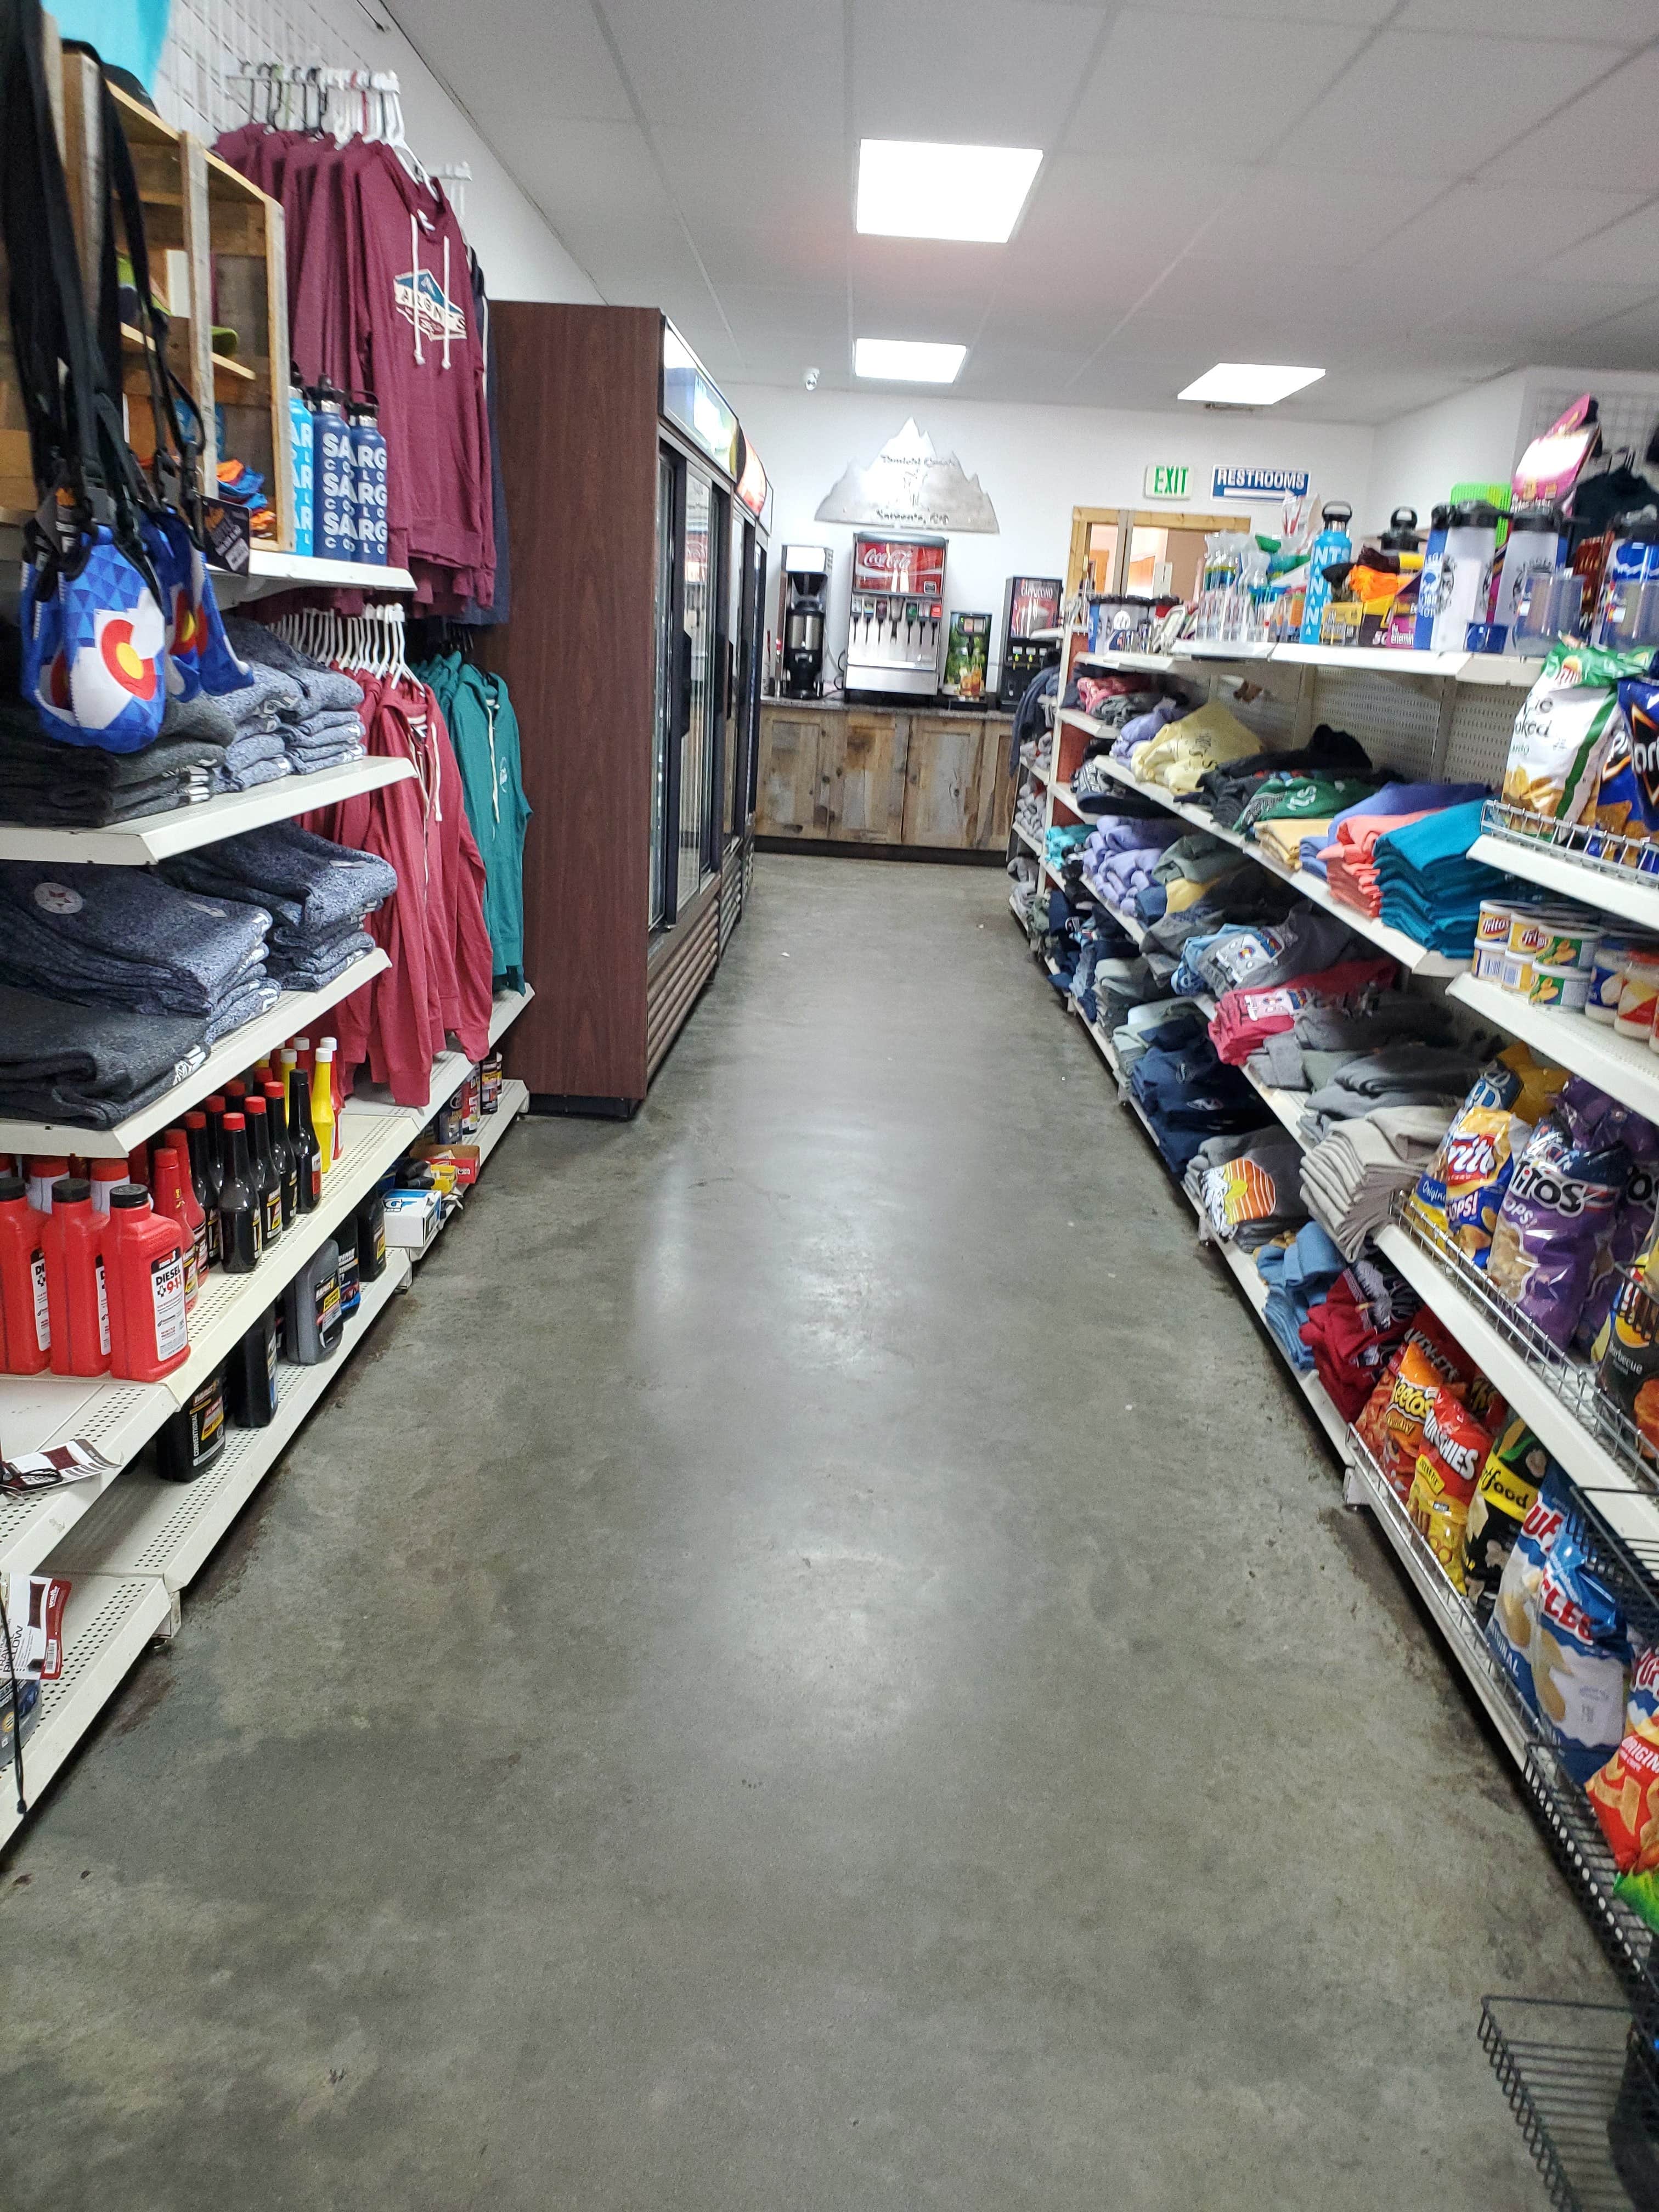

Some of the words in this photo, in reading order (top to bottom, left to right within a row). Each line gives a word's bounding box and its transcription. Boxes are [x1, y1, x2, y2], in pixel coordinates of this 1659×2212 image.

[1153, 466, 1189, 494] EXIT
[1217, 467, 1305, 489] RESTROOMS
[156, 1265, 181, 1286] DIESEL
